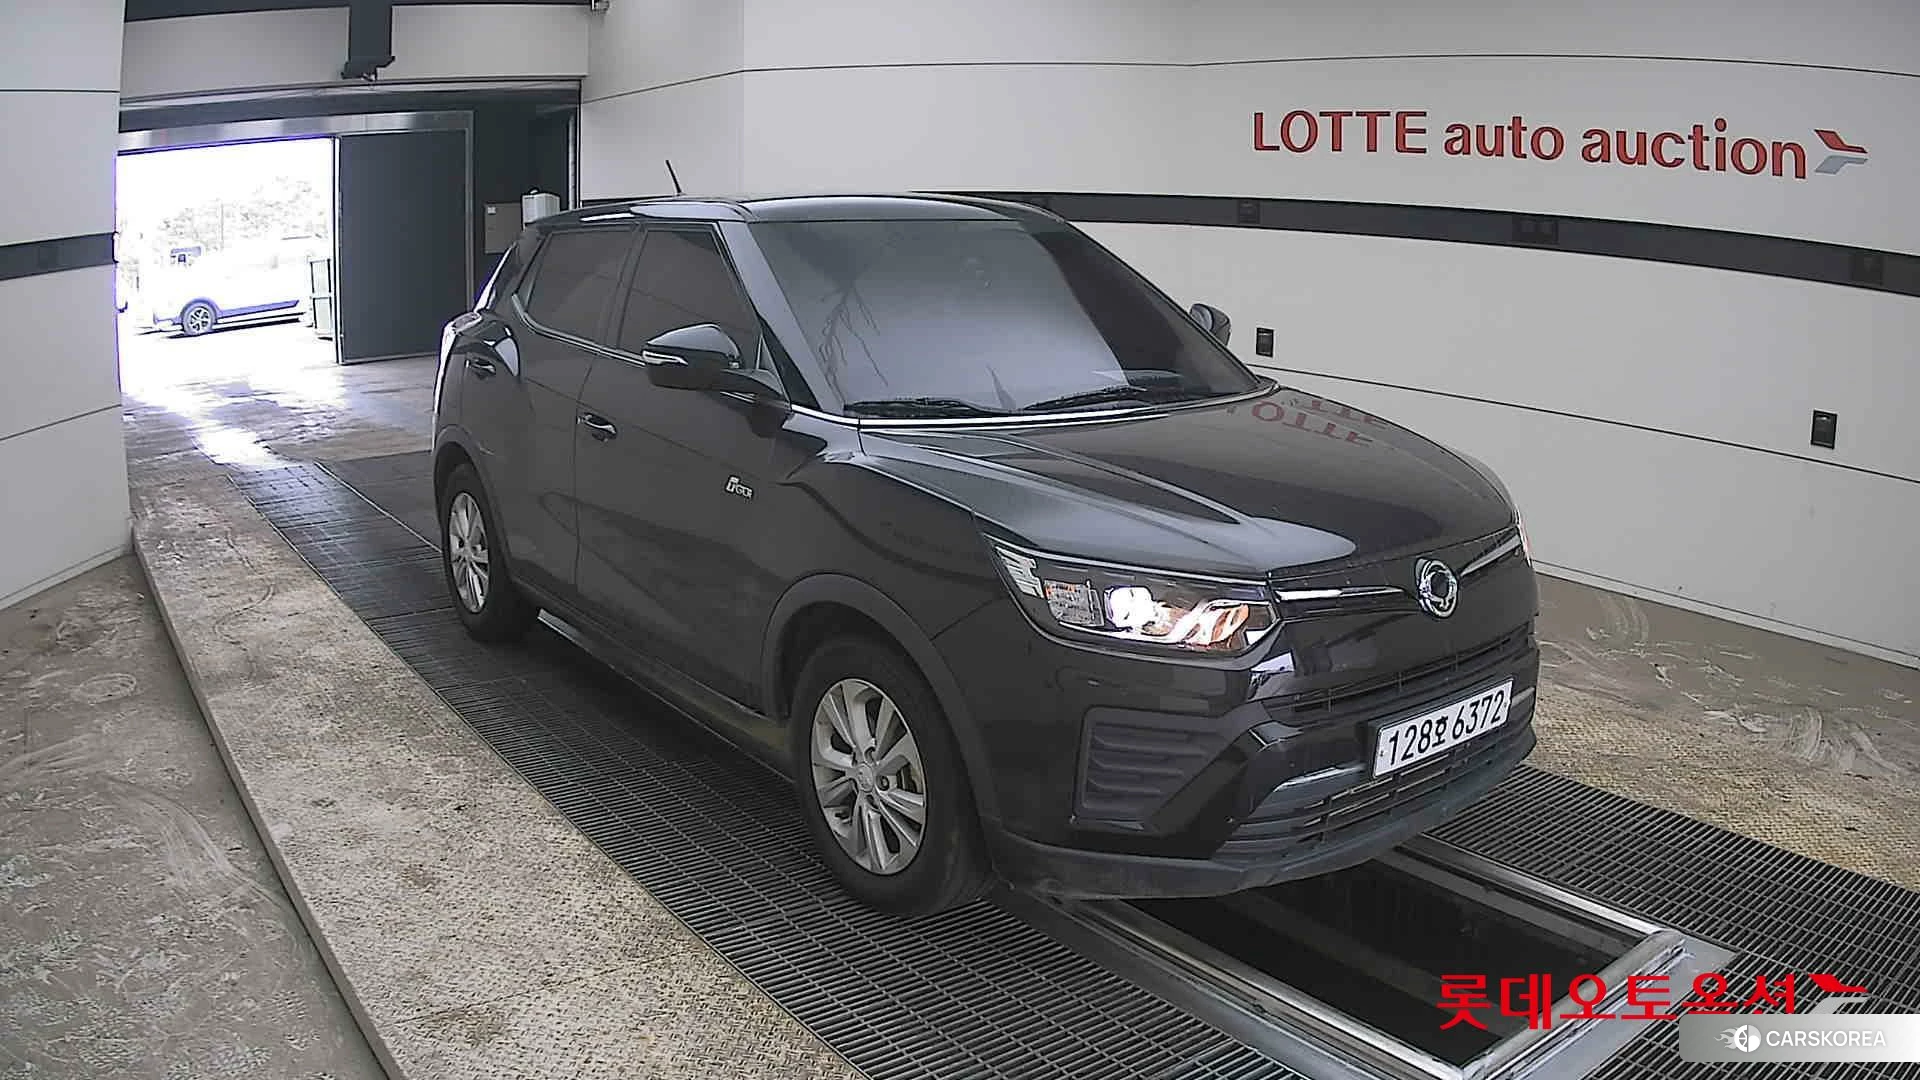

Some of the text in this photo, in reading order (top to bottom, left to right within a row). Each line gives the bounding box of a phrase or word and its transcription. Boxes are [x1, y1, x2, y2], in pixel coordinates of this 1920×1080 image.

[1253, 111, 1807, 180] LOTTE auto auction
[1452, 690, 1505, 740] 6372
